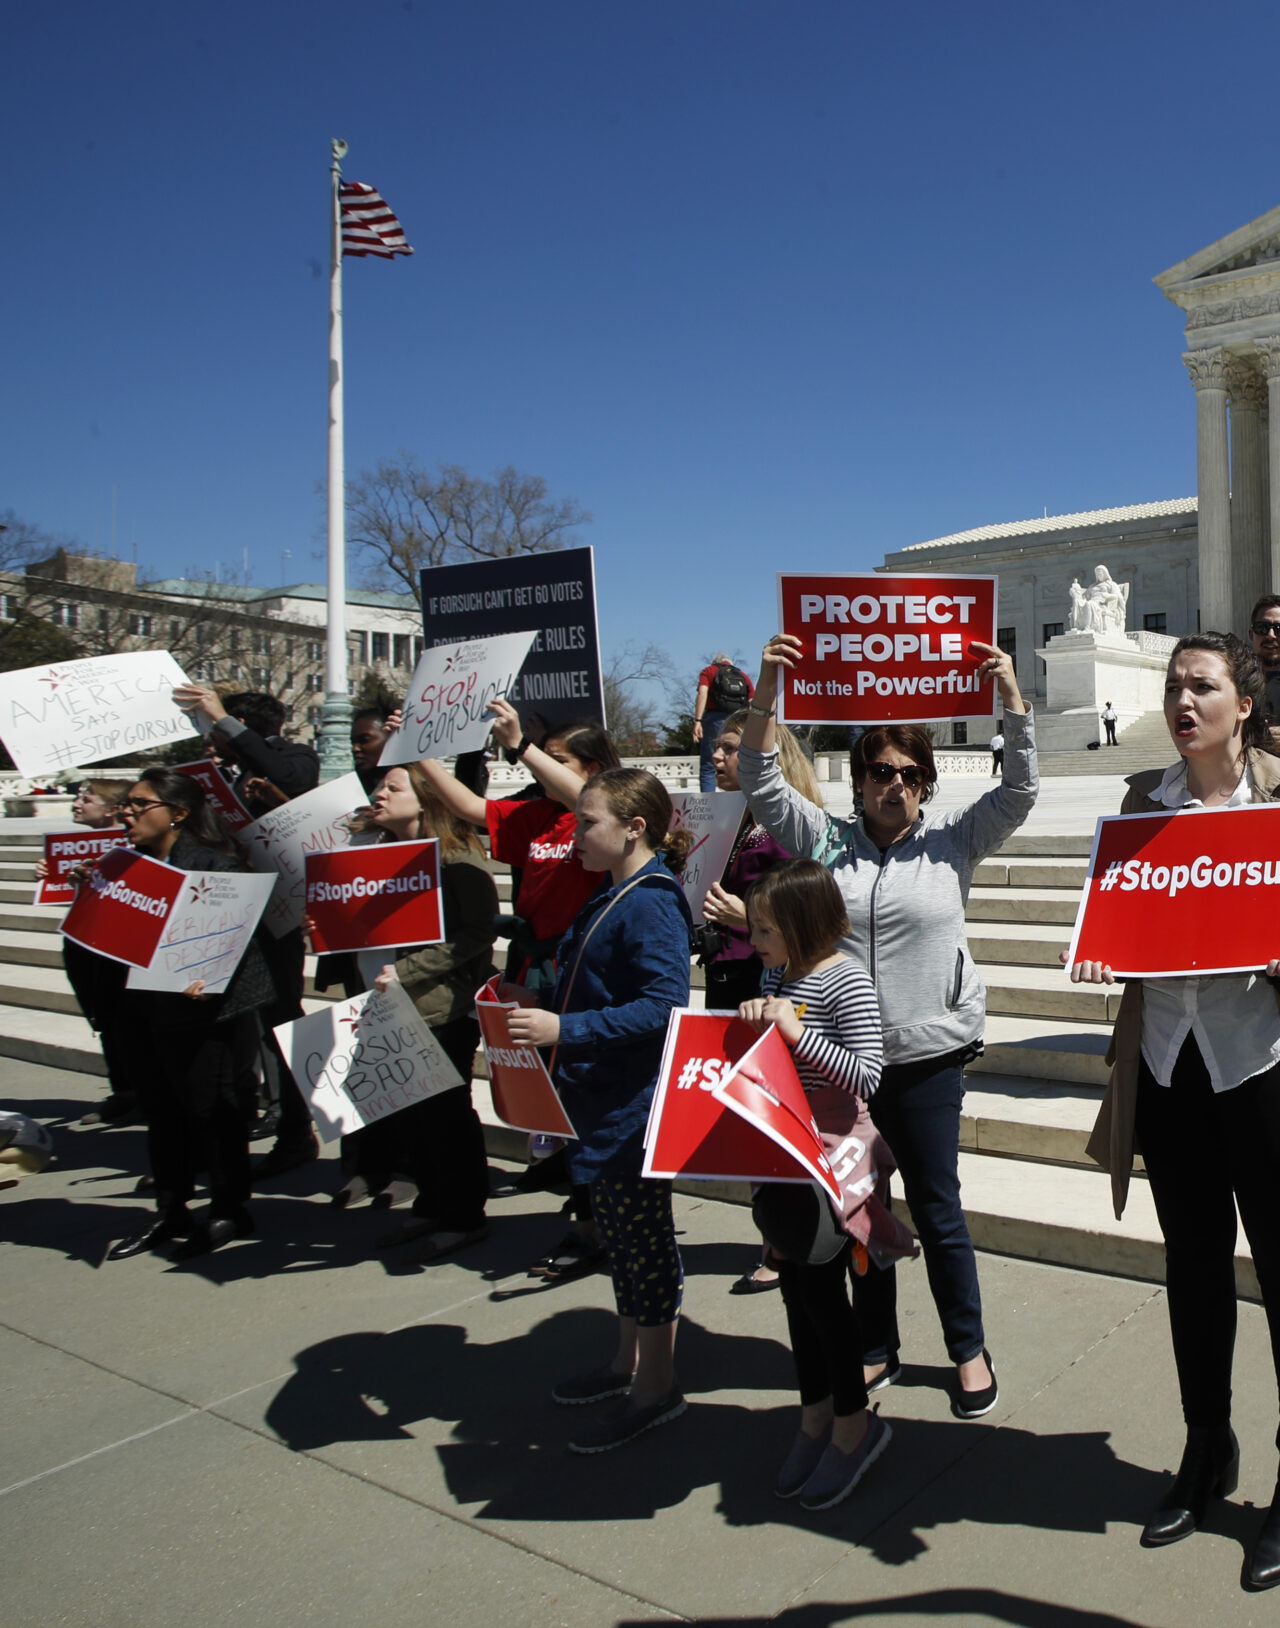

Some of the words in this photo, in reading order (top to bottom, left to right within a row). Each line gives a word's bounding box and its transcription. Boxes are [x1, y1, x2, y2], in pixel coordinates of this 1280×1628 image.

[429, 597, 439, 616] IF
[439, 592, 484, 614] GORSUCH
[484, 588, 513, 609] CAN'T
[514, 586, 534, 606] GET
[534, 584, 549, 604] 60
[549, 581, 584, 602] VOTES
[800, 594, 976, 624] PROTECT
[545, 625, 586, 652] RULES
[815, 633, 963, 663] PEOPLE
[523, 670, 591, 700] NOMINEE
[793, 679, 823, 695] Not
[826, 680, 853, 696] the
[856, 669, 980, 696] Powerful
[11, 673, 174, 728] AMERICA
[417, 673, 512, 754] GORSUCH
[71, 711, 121, 732] SAYS
[44, 715, 190, 767] #STOPGORSUC
[307, 870, 431, 904] #StopGorsuch
[339, 1057, 415, 1103] BAD
